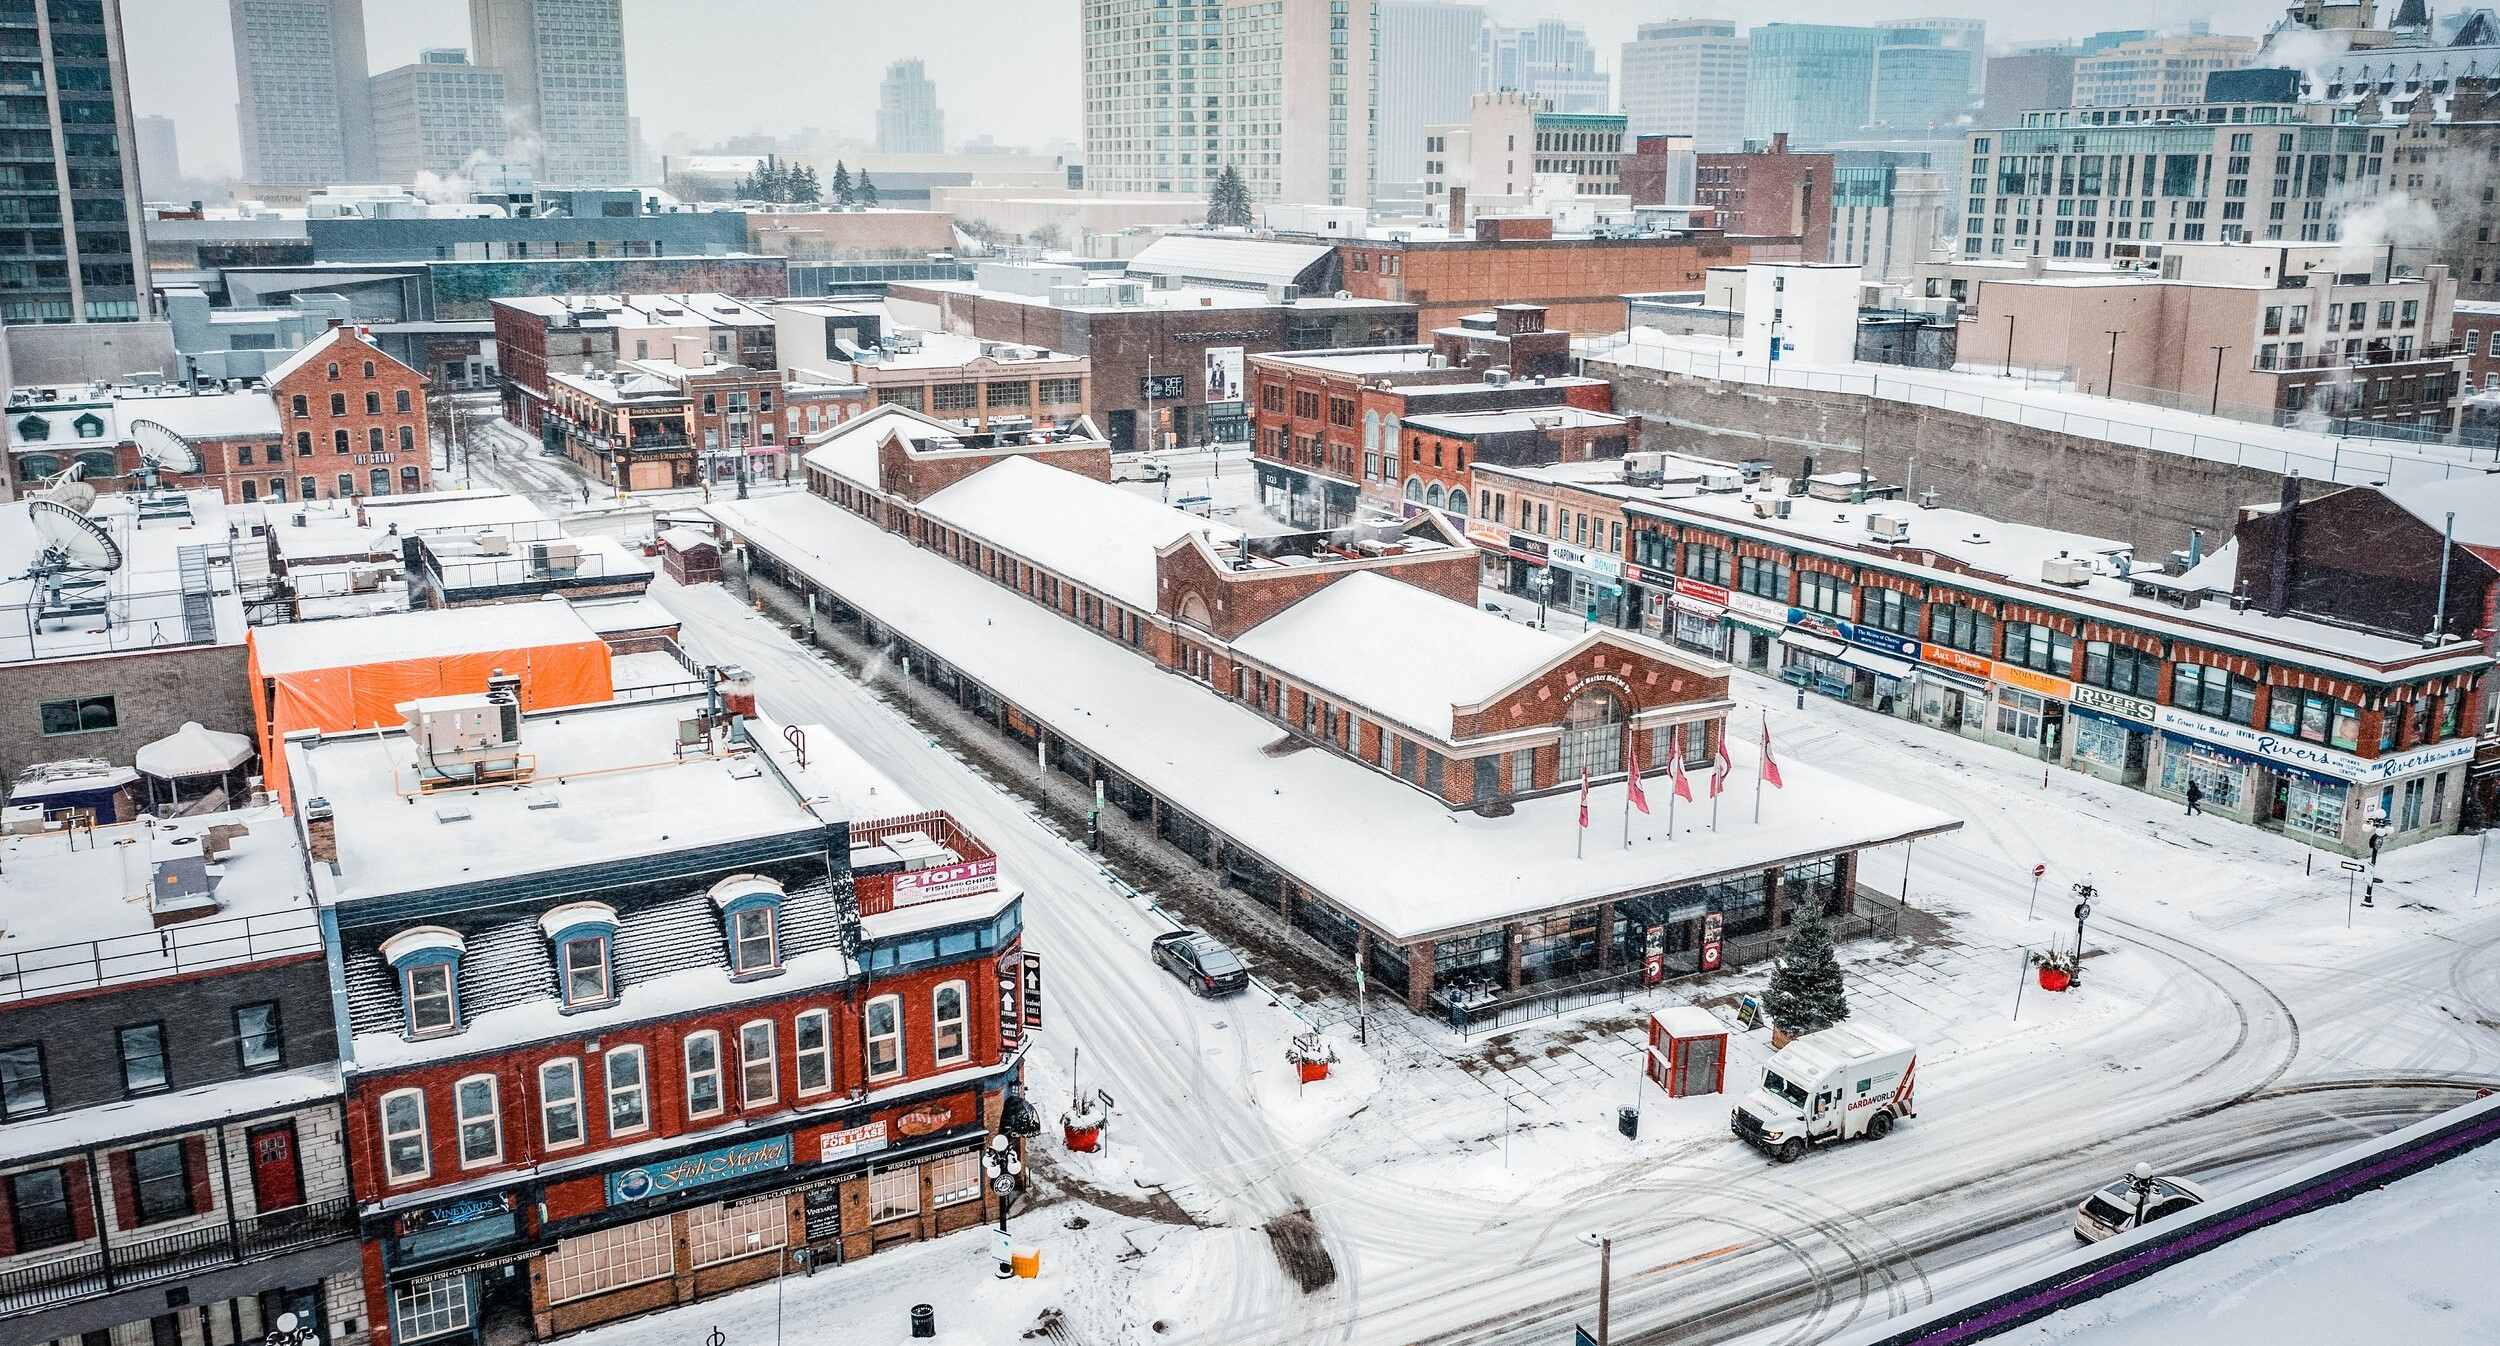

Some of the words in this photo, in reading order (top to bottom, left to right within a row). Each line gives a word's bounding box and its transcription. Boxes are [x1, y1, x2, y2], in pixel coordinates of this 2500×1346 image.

[1164, 376, 1182, 388] OFF
[1165, 386, 1182, 397] 5TH
[353, 453, 367, 465] THE
[370, 452, 395, 465] GRAND
[1569, 680, 1585, 694] Ward
[1585, 674, 1606, 684] Market
[2077, 686, 2154, 720] RIVERS
[2257, 736, 2330, 765] Rivers
[2383, 753, 2431, 778] Rivers
[896, 875, 918, 890] 2
[918, 866, 965, 885] for
[967, 862, 977, 877] 1
[925, 884, 949, 893] FISH
[964, 875, 996, 886] CHIPS
[1847, 1090, 1896, 1111] GARDAWORLD
[822, 1138, 848, 1148] FOR
[851, 1128, 885, 1142] LEASE
[656, 1157, 707, 1190] Fish
[709, 1143, 785, 1173] Market
[736, 1196, 754, 1207] FRESH
[755, 1194, 768, 1203] FISH
[771, 1189, 792, 1198] CLAMS
[794, 1183, 814, 1193] FRESH
[814, 1180, 827, 1188] FISH
[830, 1173, 857, 1185] SCALLOPS
[431, 1199, 494, 1220] VINEYARDS
[411, 1274, 433, 1285] FRESH
[433, 1271, 449, 1281] FISH
[452, 1265, 472, 1276] CRAB
[476, 1260, 498, 1271] FRESH
[498, 1256, 513, 1266] FISH
[516, 1250, 542, 1262] SHRIMP
